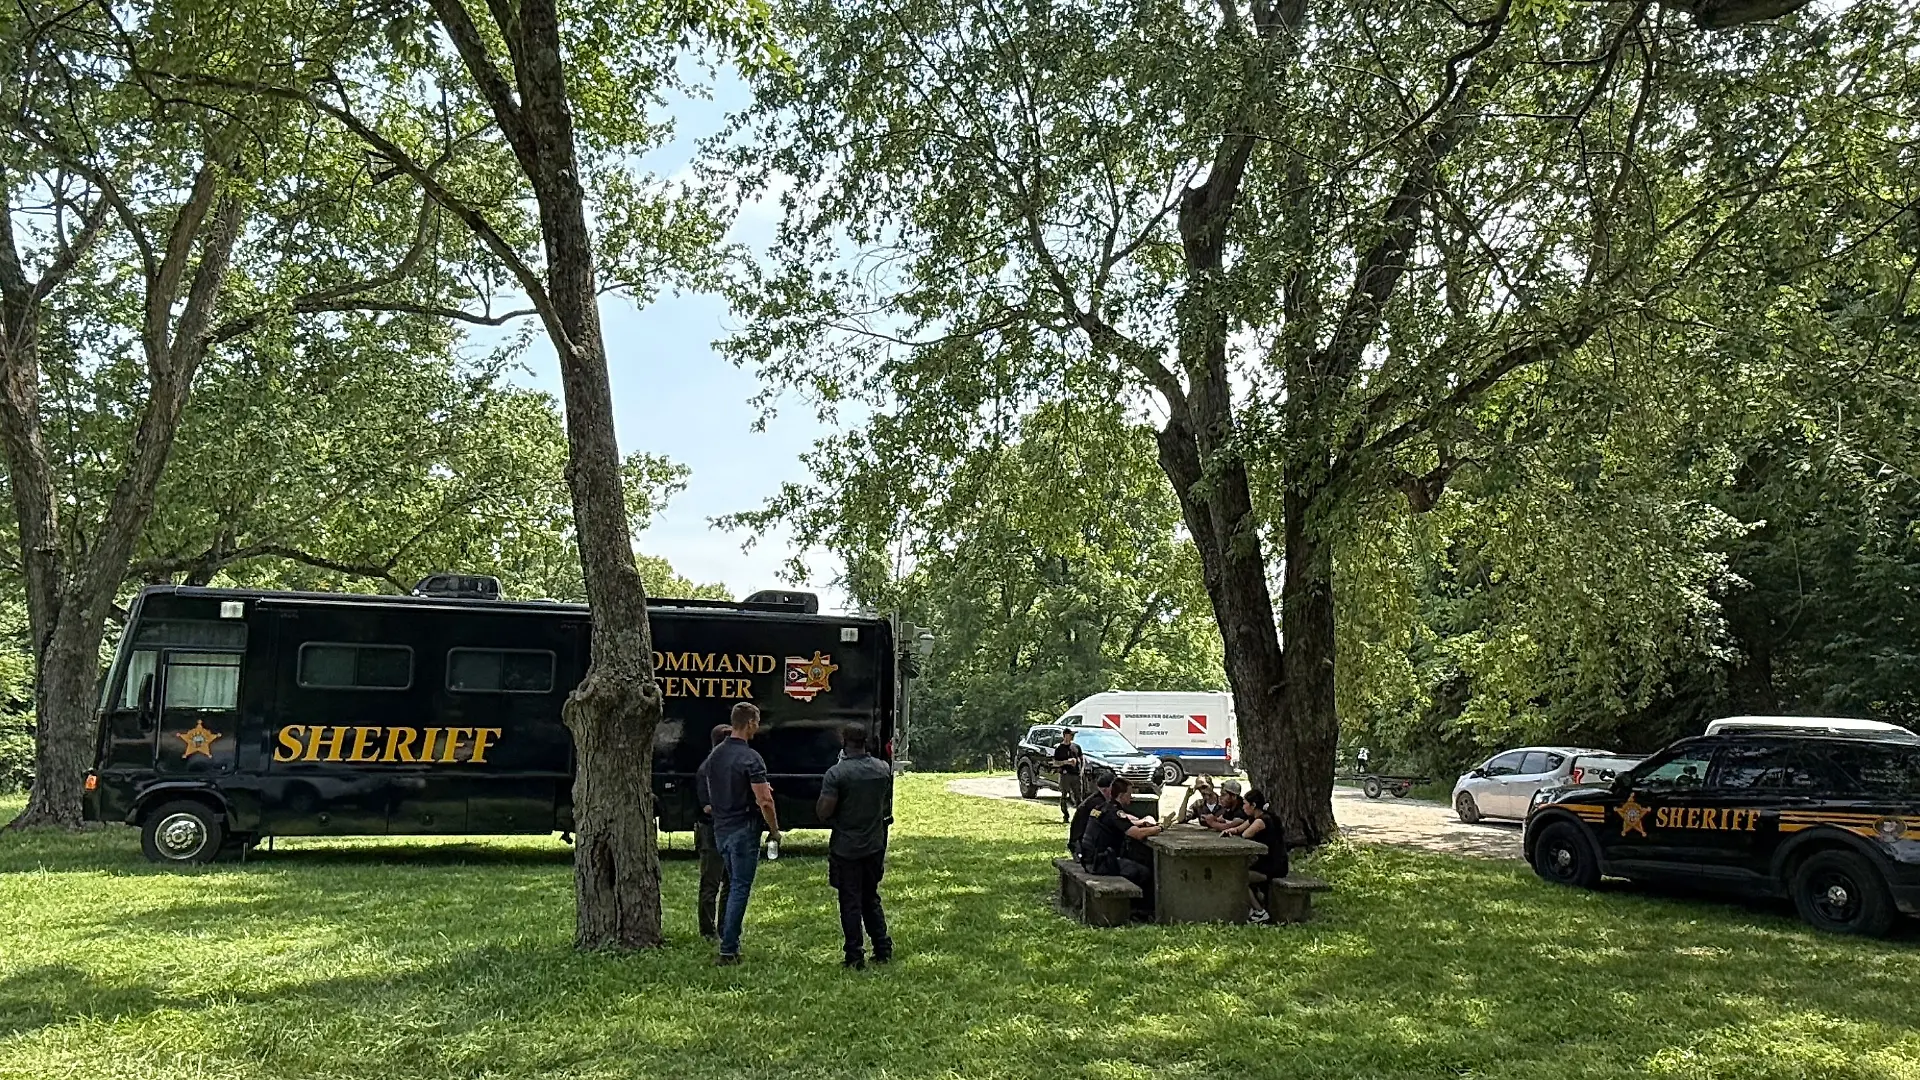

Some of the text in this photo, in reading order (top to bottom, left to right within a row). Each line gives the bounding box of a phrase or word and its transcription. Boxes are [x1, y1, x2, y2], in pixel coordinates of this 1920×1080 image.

[652, 651, 776, 674] OMMAND
[654, 676, 753, 698] ENTER
[273, 724, 502, 763] SHERIFF
[1656, 806, 1761, 831] SHERIFF
